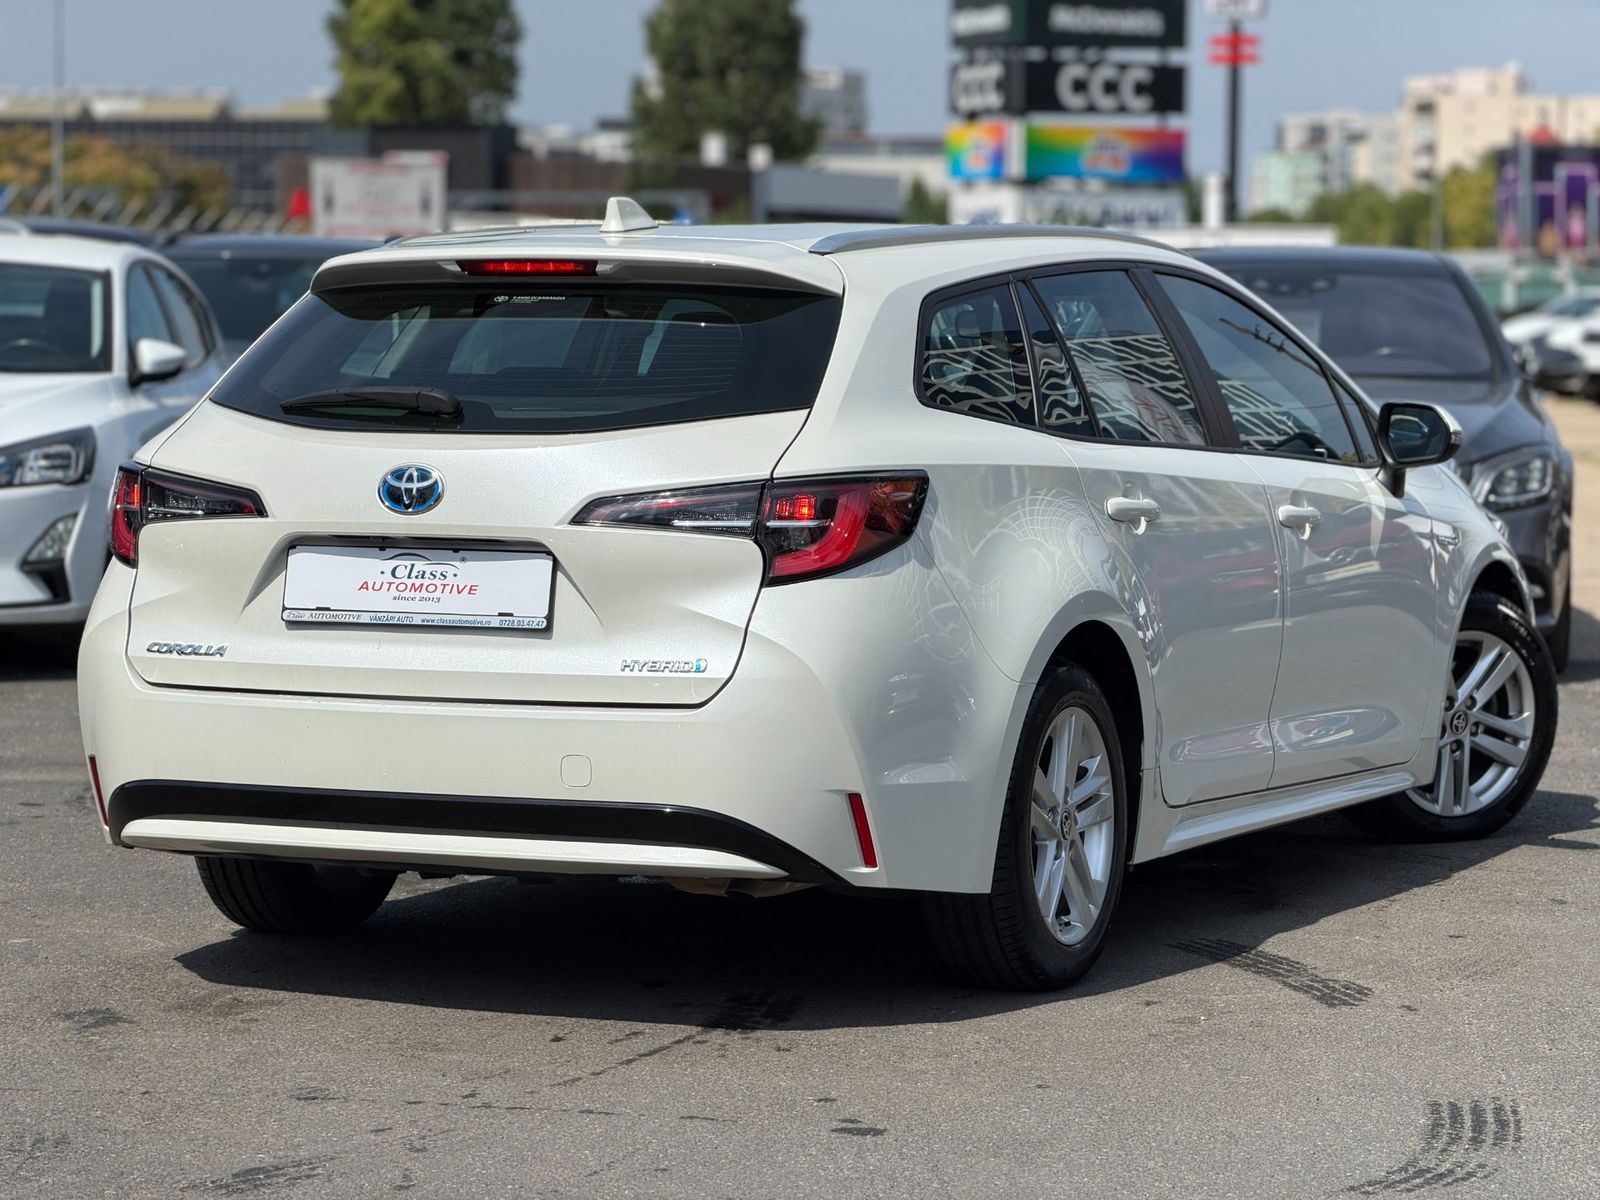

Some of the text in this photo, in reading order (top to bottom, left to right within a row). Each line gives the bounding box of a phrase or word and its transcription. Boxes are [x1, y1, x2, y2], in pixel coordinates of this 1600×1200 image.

[1055, 62, 1154, 112] CCC
[390, 563, 448, 581] Class
[358, 581, 479, 595] AUTOMOTIVE
[392, 594, 417, 602] since
[308, 612, 362, 621] AUTOMOTIVE
[420, 617, 545, 628] www.classautomotive.ro 0728.03.47.47
[146, 642, 228, 657] COROLLA
[620, 659, 694, 673] HYBRID
